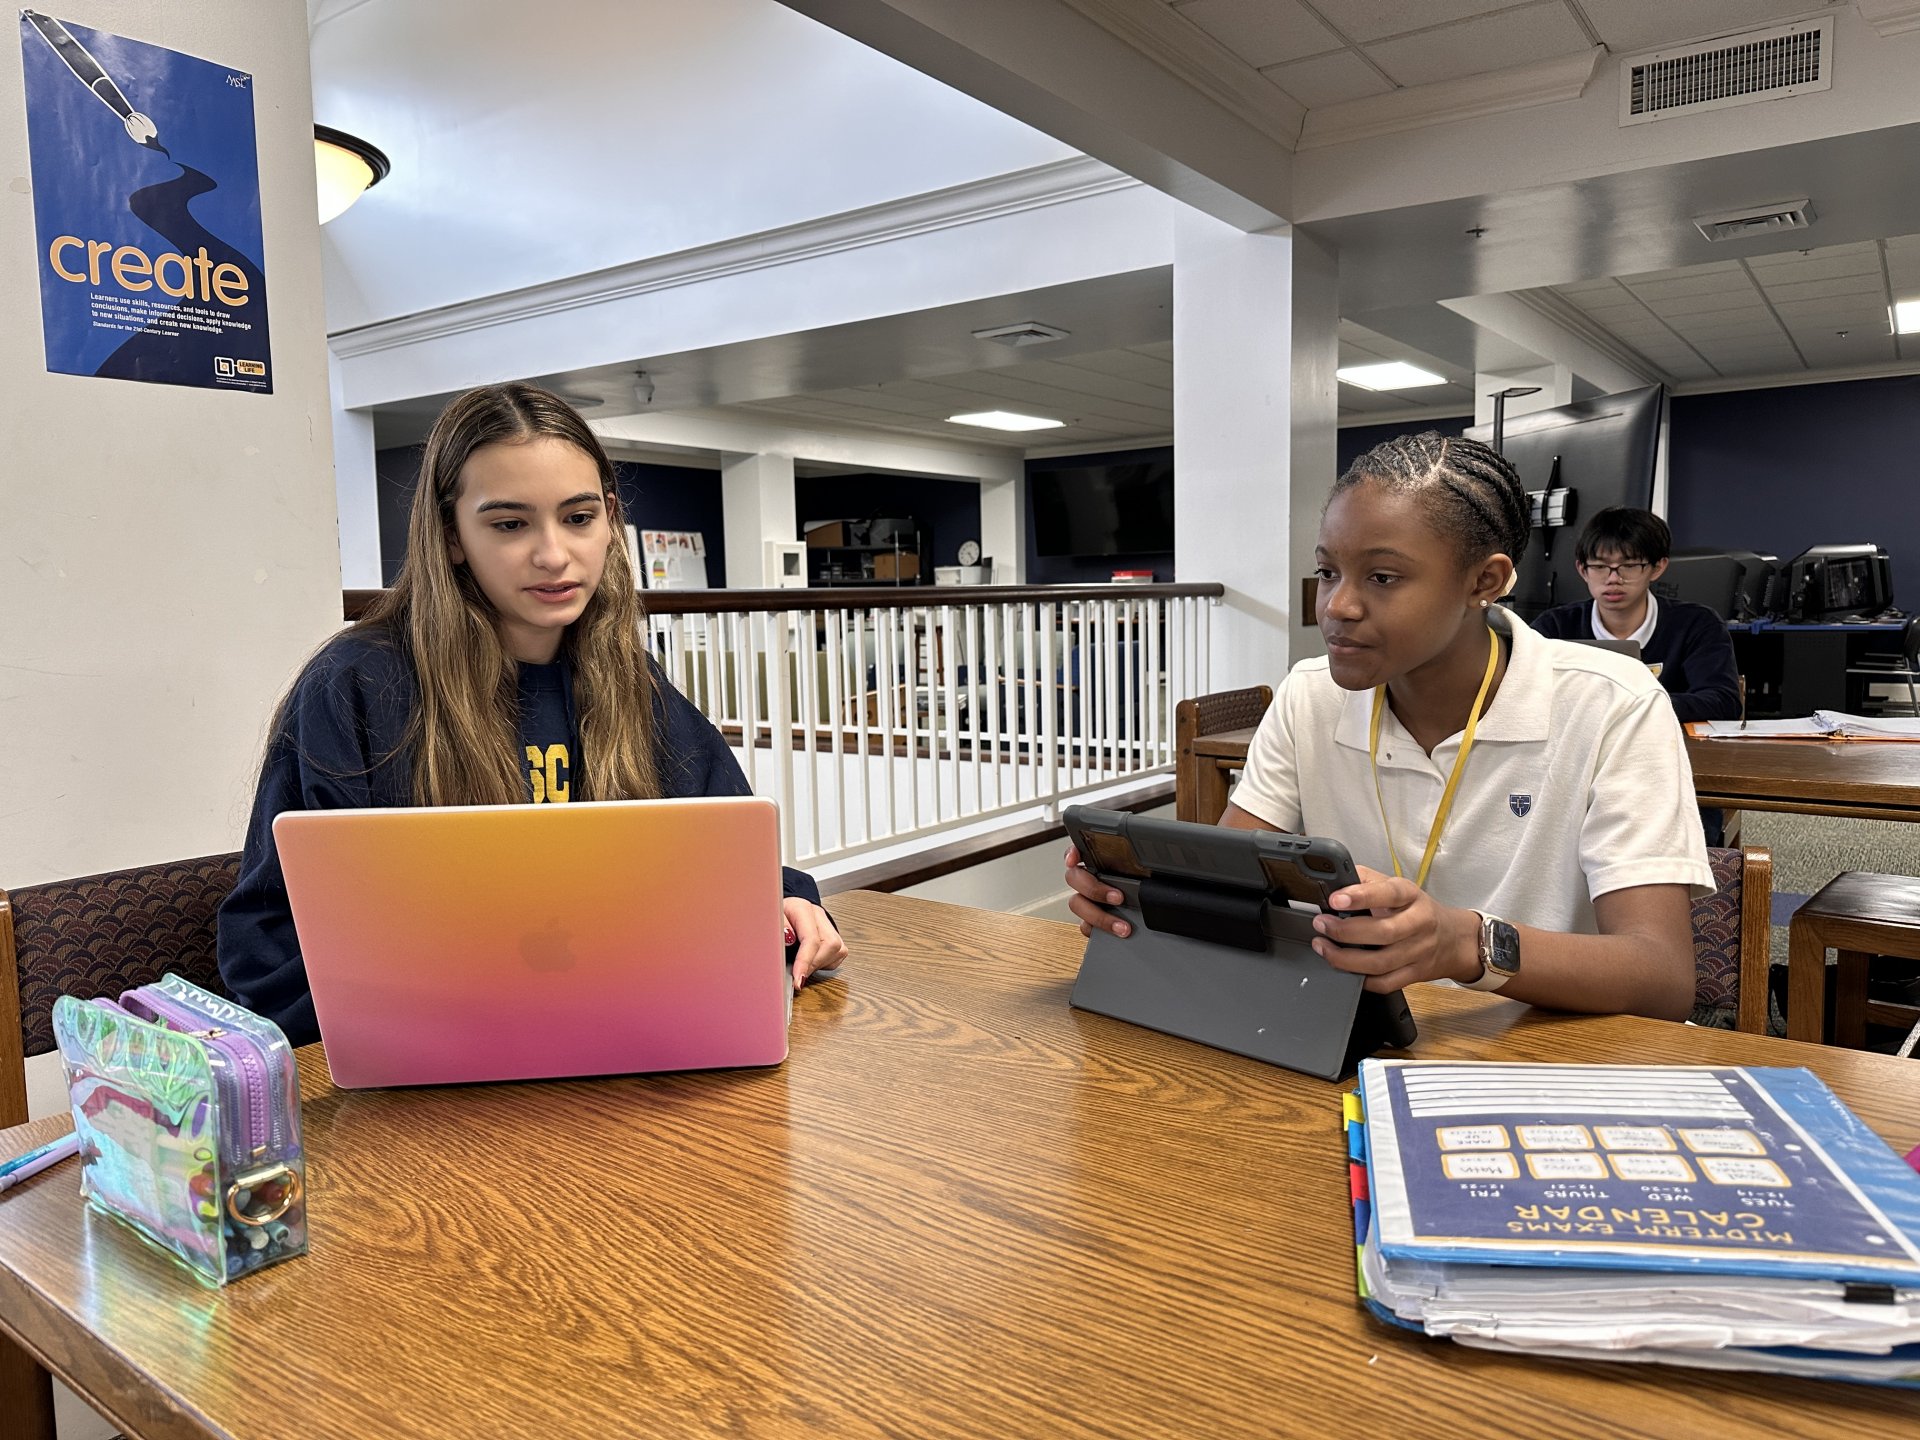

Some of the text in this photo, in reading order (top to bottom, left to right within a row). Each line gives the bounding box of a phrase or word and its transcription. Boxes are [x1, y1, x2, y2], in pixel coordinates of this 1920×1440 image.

[49, 235, 249, 306] create
[90, 292, 118, 303] Learners
[132, 299, 150, 308] skills,
[151, 302, 182, 312] resources,
[195, 307, 208, 316] tools
[209, 309, 215, 317] to
[216, 311, 230, 319] draw
[91, 302, 251, 330] conclusions, make informed decisions, apply knowledge
[91, 309, 98, 317] to
[114, 312, 146, 324] situations,
[147, 317, 158, 325] and
[160, 319, 178, 327] create
[192, 323, 223, 334] knowledge.
[92, 320, 116, 329] Standards
[161, 329, 179, 337] Learner
[1469, 1190, 1501, 1198] FRI
[1543, 1190, 1610, 1199] THURS
[1647, 1192, 1694, 1202] WED
[1740, 1197, 1796, 1208] TUES
[1513, 1204, 1766, 1228] CALENDAR
[1506, 1220, 1794, 1244] MIDTERM EXAMS
